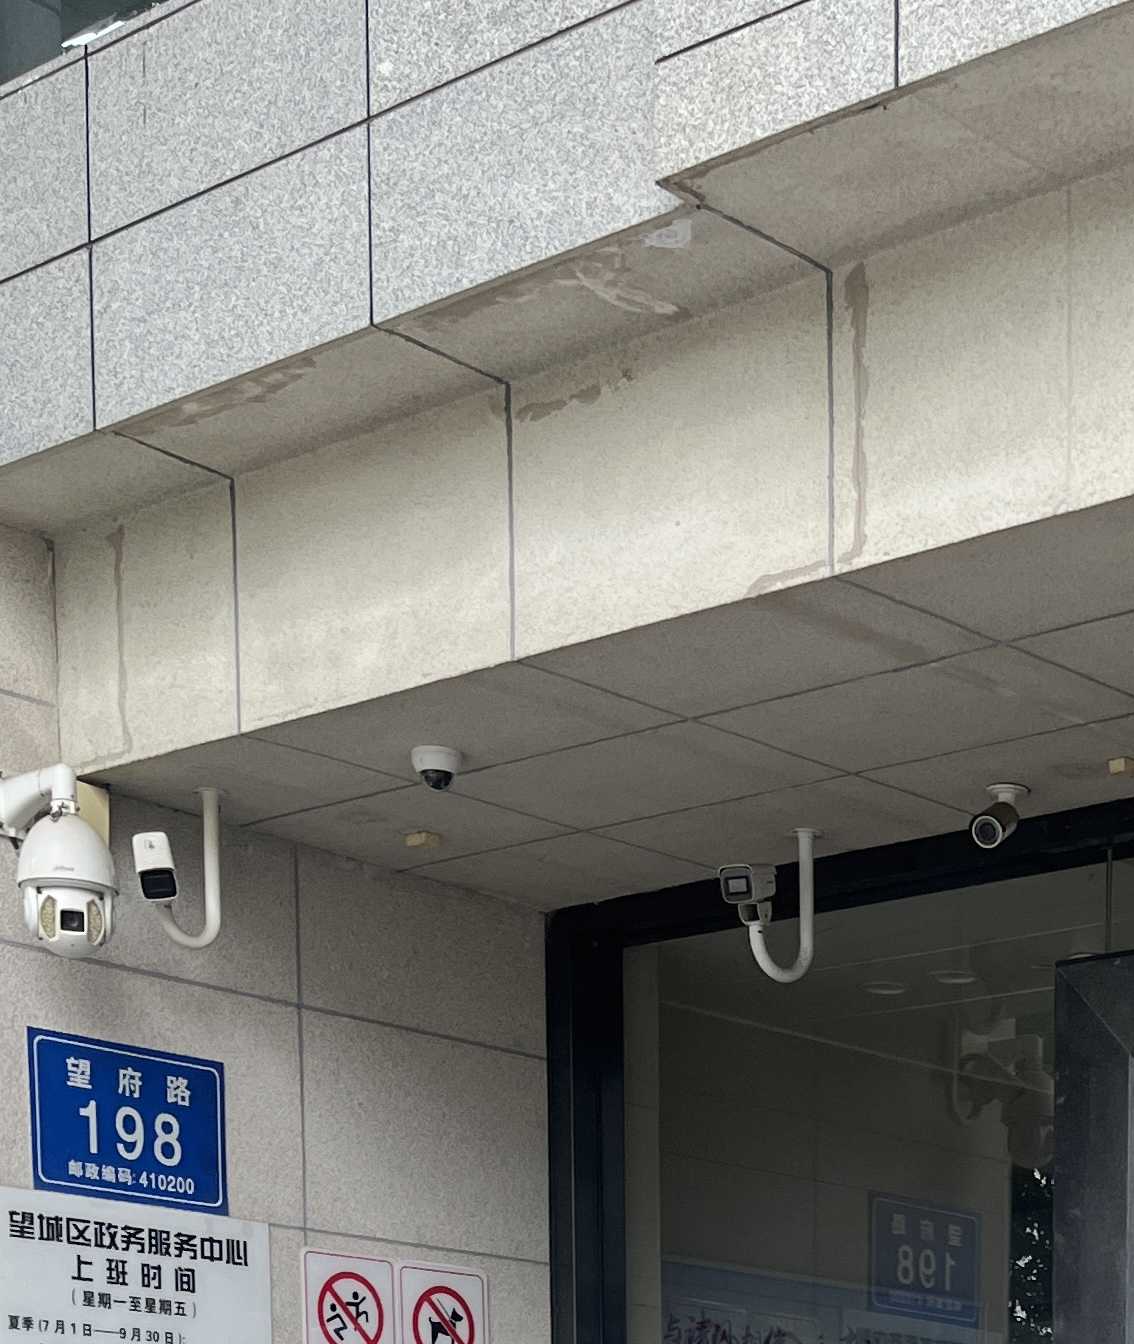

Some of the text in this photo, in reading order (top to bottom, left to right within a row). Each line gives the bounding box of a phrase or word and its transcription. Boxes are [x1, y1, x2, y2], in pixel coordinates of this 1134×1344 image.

[66, 1056, 191, 1106] 望府路
[79, 1100, 182, 1167] 198
[68, 1160, 195, 1195] 邮政编码:410200
[8, 1210, 248, 1267] 望城区政务服务中心
[71, 1254, 196, 1293] 上班时间
